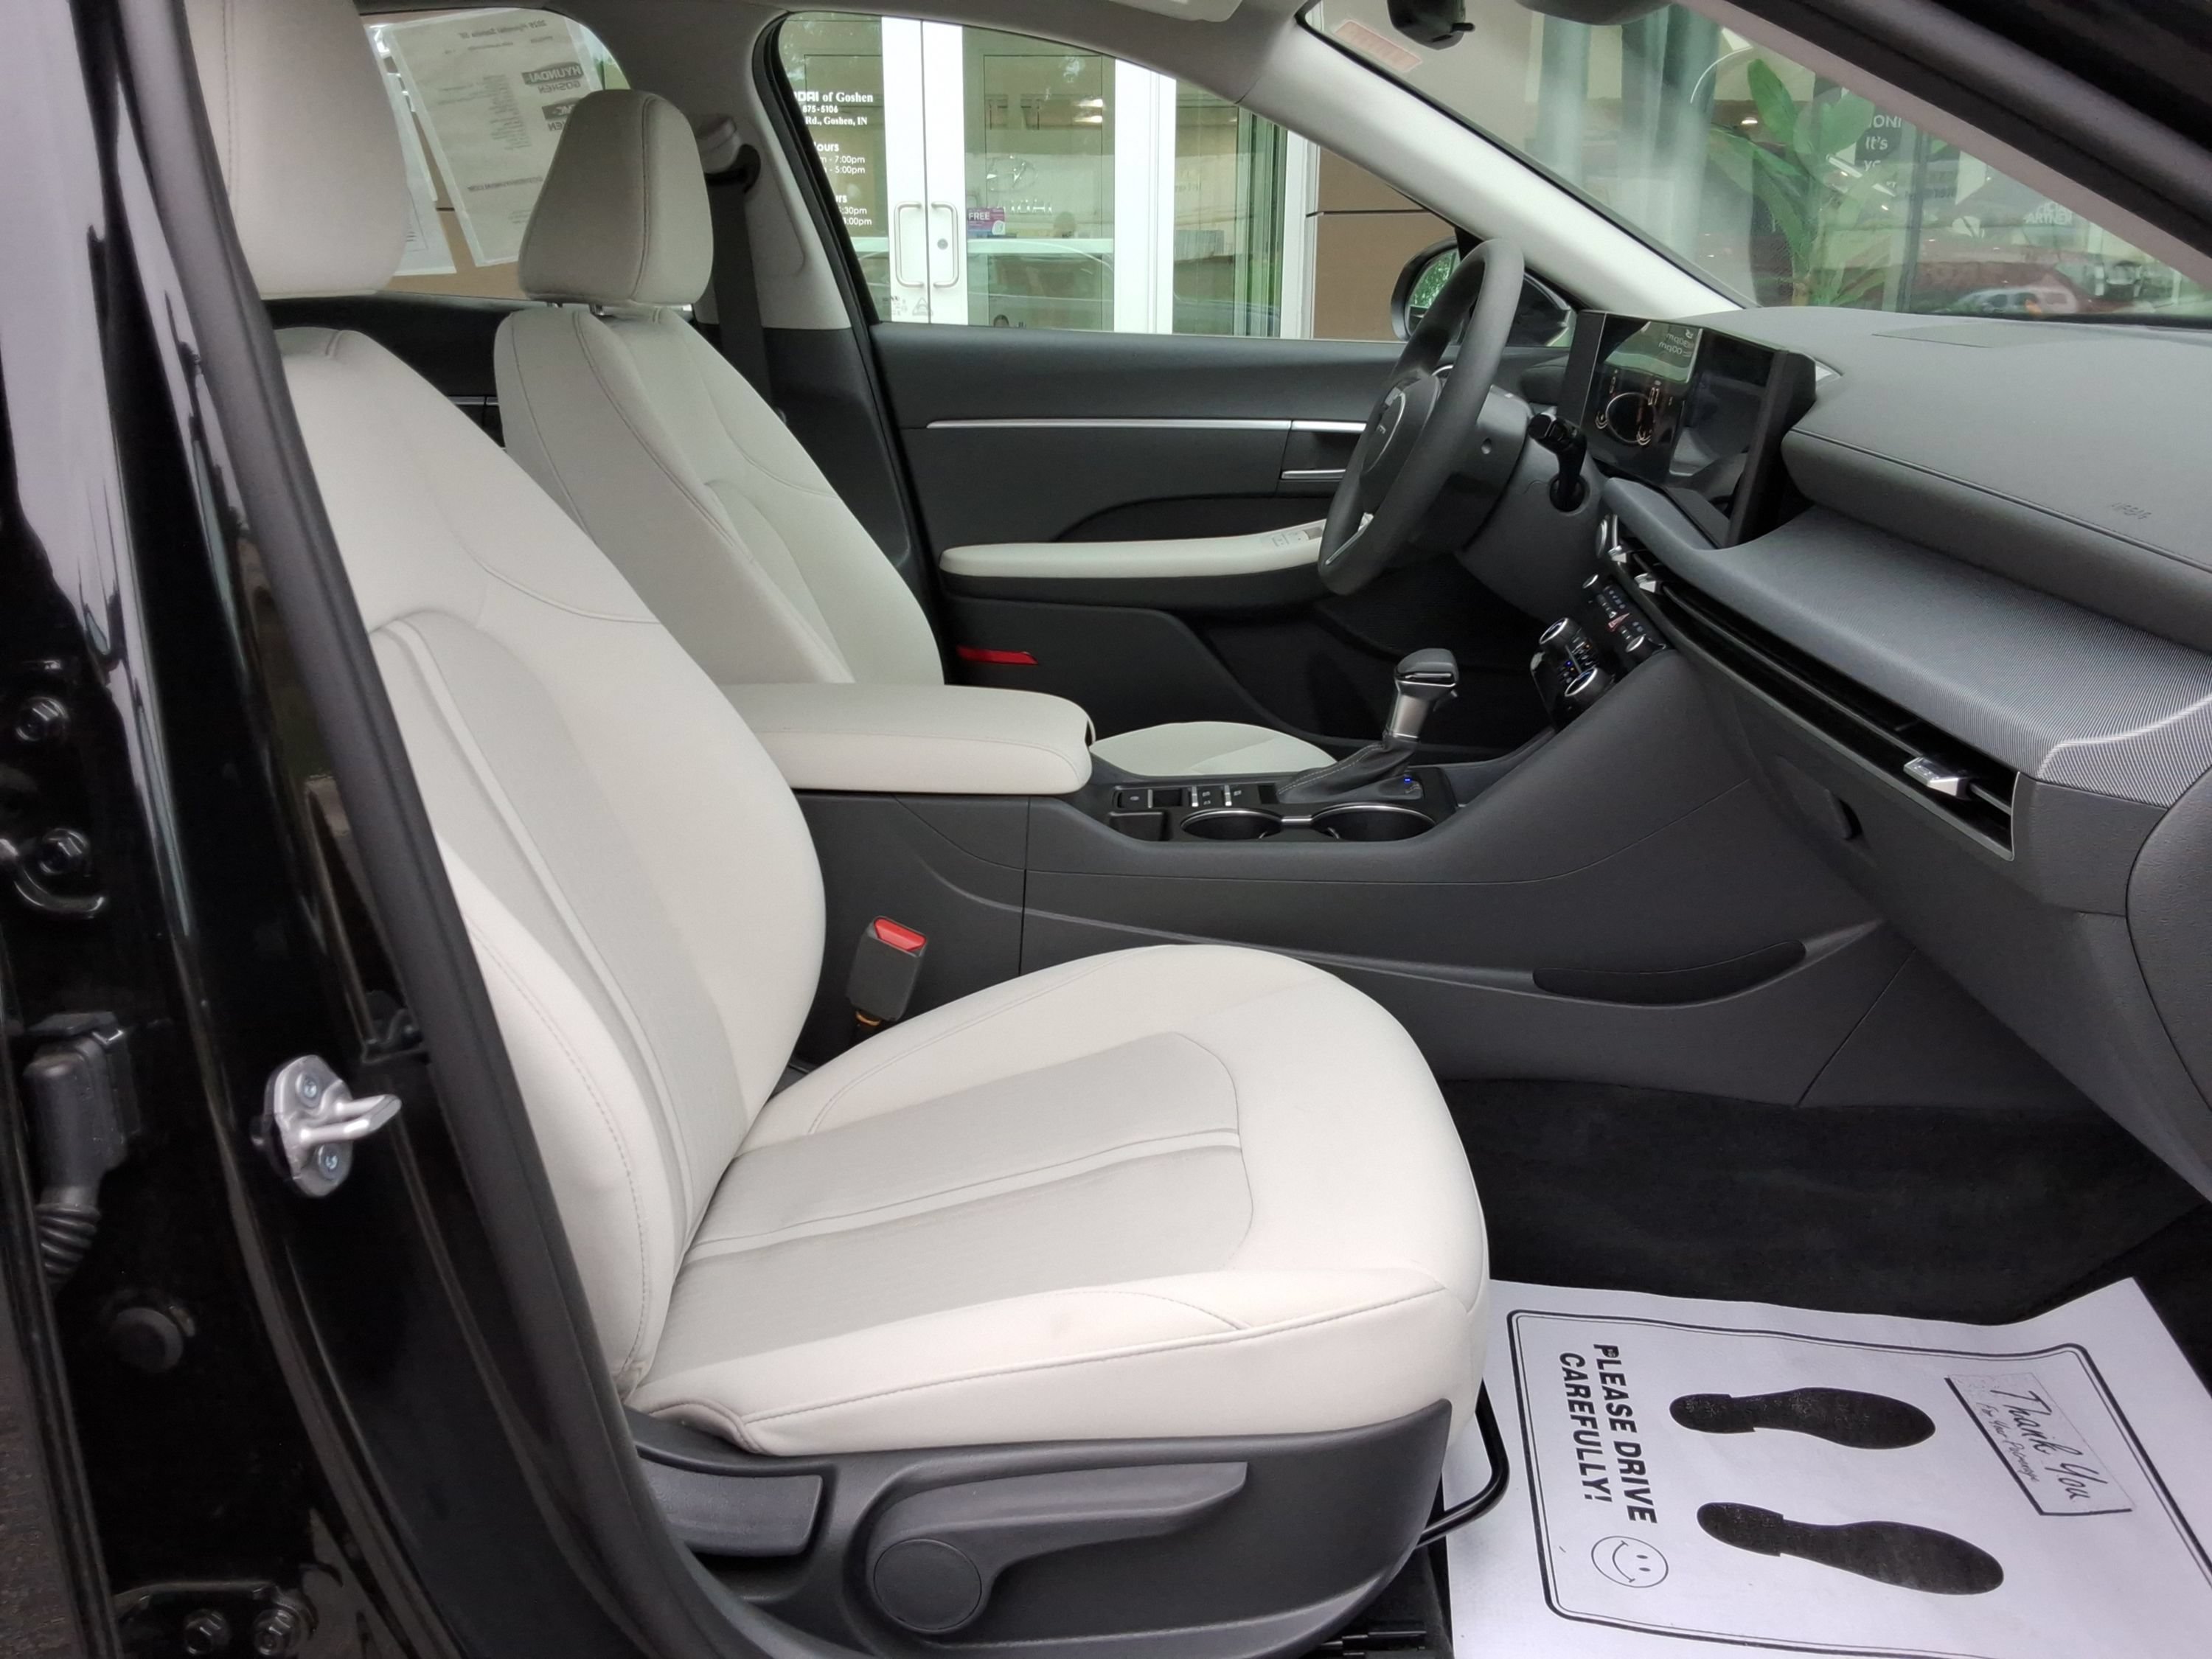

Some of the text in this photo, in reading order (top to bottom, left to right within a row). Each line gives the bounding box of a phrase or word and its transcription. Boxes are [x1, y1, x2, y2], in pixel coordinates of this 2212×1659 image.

[822, 92, 833, 102] of
[835, 92, 873, 102] Goshen
[805, 116, 867, 126] Rd., Goshen, IN
[814, 142, 839, 152] ours
[1865, 136, 1888, 150] It's
[835, 156, 866, 164] 7:00pm
[835, 166, 866, 175] 5:00pm
[968, 212, 990, 220] FREE
[1559, 1352, 1613, 1503] CAREFULLY!
[1593, 1343, 1658, 1524] PLEASE DRIVE
[1989, 1389, 2108, 1500] Thank You
